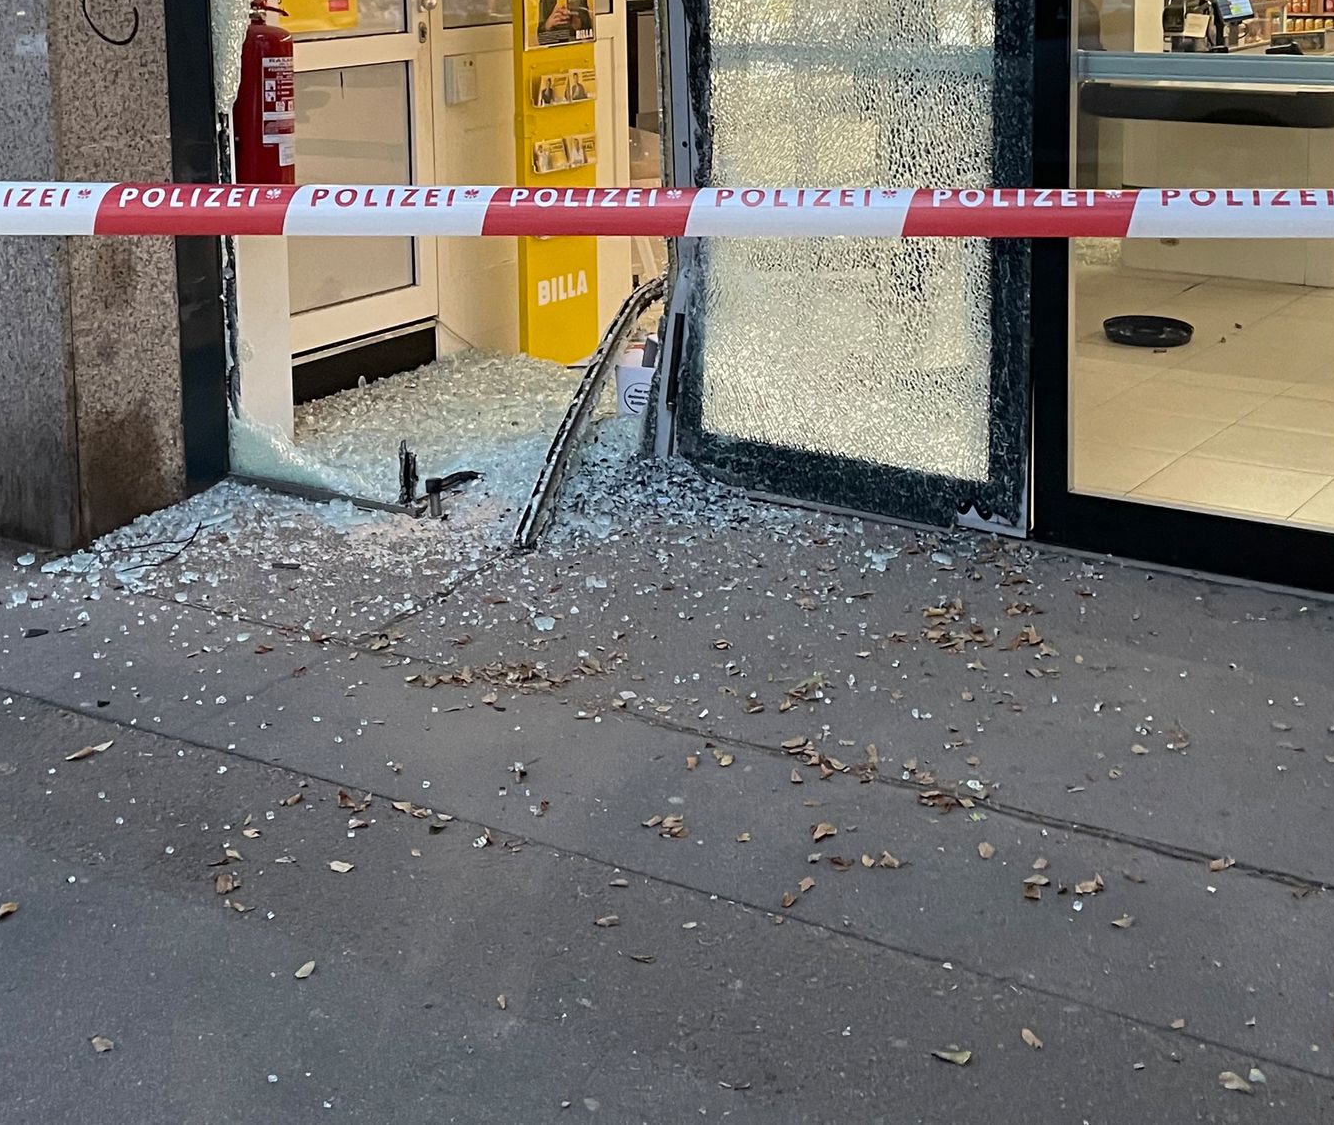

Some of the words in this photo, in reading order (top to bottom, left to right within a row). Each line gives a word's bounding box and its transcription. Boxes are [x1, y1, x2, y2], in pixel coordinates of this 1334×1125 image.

[119, 187, 261, 208] POLIZEI
[310, 188, 455, 208] POLIZEI
[509, 188, 658, 208] POLIZEI
[714, 189, 872, 208] POLIZEI
[931, 189, 1096, 208] POLIZEI
[537, 270, 588, 307] BILLA
